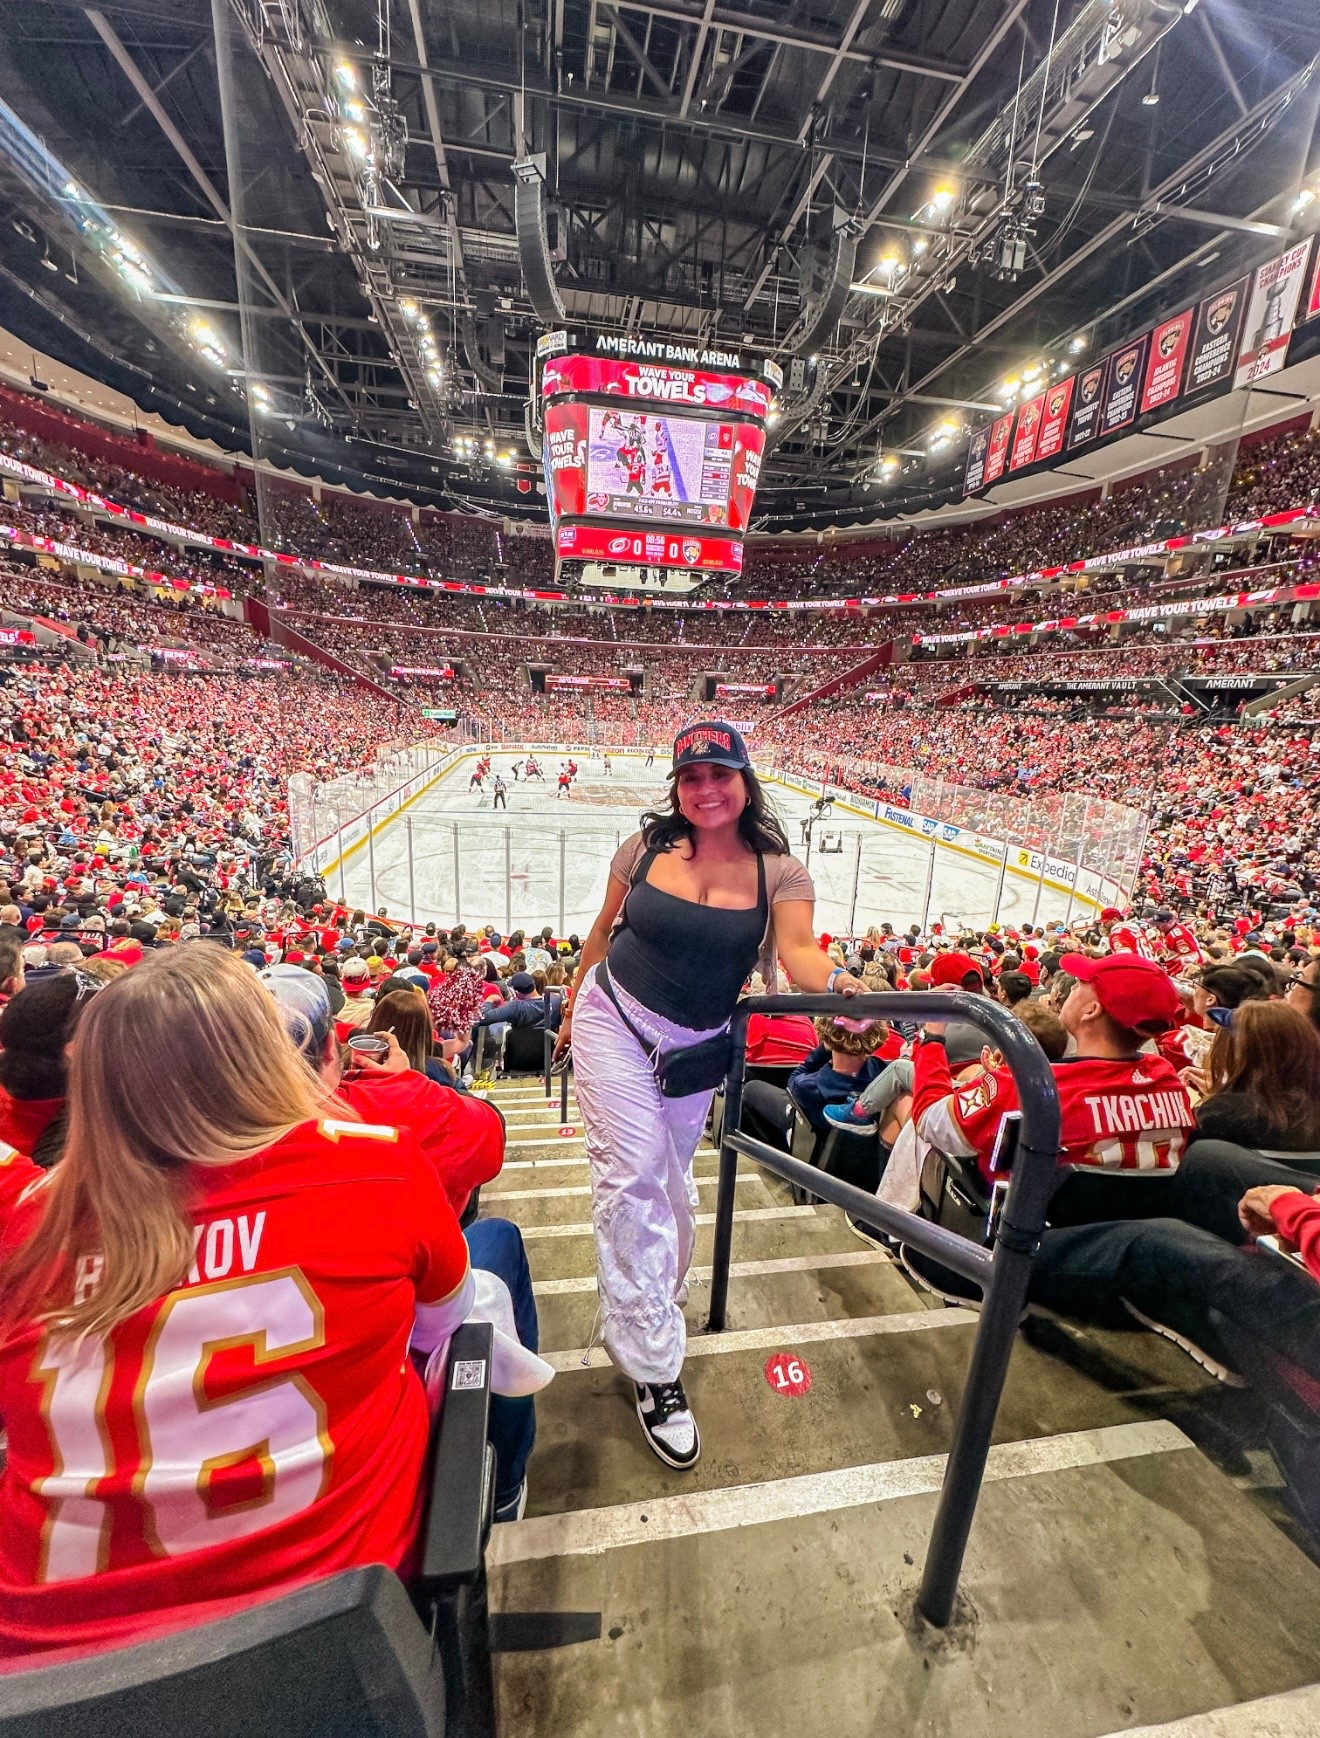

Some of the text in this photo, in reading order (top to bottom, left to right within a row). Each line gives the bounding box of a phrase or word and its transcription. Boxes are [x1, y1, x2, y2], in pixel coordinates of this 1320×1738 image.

[1290, 243, 1308, 261] CUP
[1195, 340, 1232, 366] CONFERENCE
[1201, 333, 1229, 354] EASTERN
[666, 345, 699, 363] BANK
[700, 350, 740, 369] ARENA
[1153, 358, 1178, 378] ATLANTIC
[1193, 351, 1229, 376] CHAMPIONS
[639, 366, 695, 383] WAVE YOUR
[1196, 364, 1222, 384] 2023-24
[1247, 358, 1271, 380] 2024
[625, 375, 707, 404] TOWELS
[549, 428, 575, 442] WAVE
[551, 441, 574, 456] YOUR
[21, 464, 55, 487] TOWELS
[53, 541, 129, 574] WAVE YOUR TOWELS
[633, 539, 642, 556] 0
[669, 543, 678, 559] 0
[1085, 541, 1167, 568] WAVE YOUR TOWELS
[1127, 595, 1239, 620] WAVE YOUR TOWELS
[1066, 681, 1137, 690] THE AMERANT VAULT
[1205, 678, 1256, 689] AMERANT
[675, 729, 731, 758] PANTHERS
[884, 806, 914, 828] FASTENAL
[1084, 1091, 1193, 1134] TKACHUK
[772, 1361, 804, 1389] 16
[29, 1265, 336, 1585] 16
